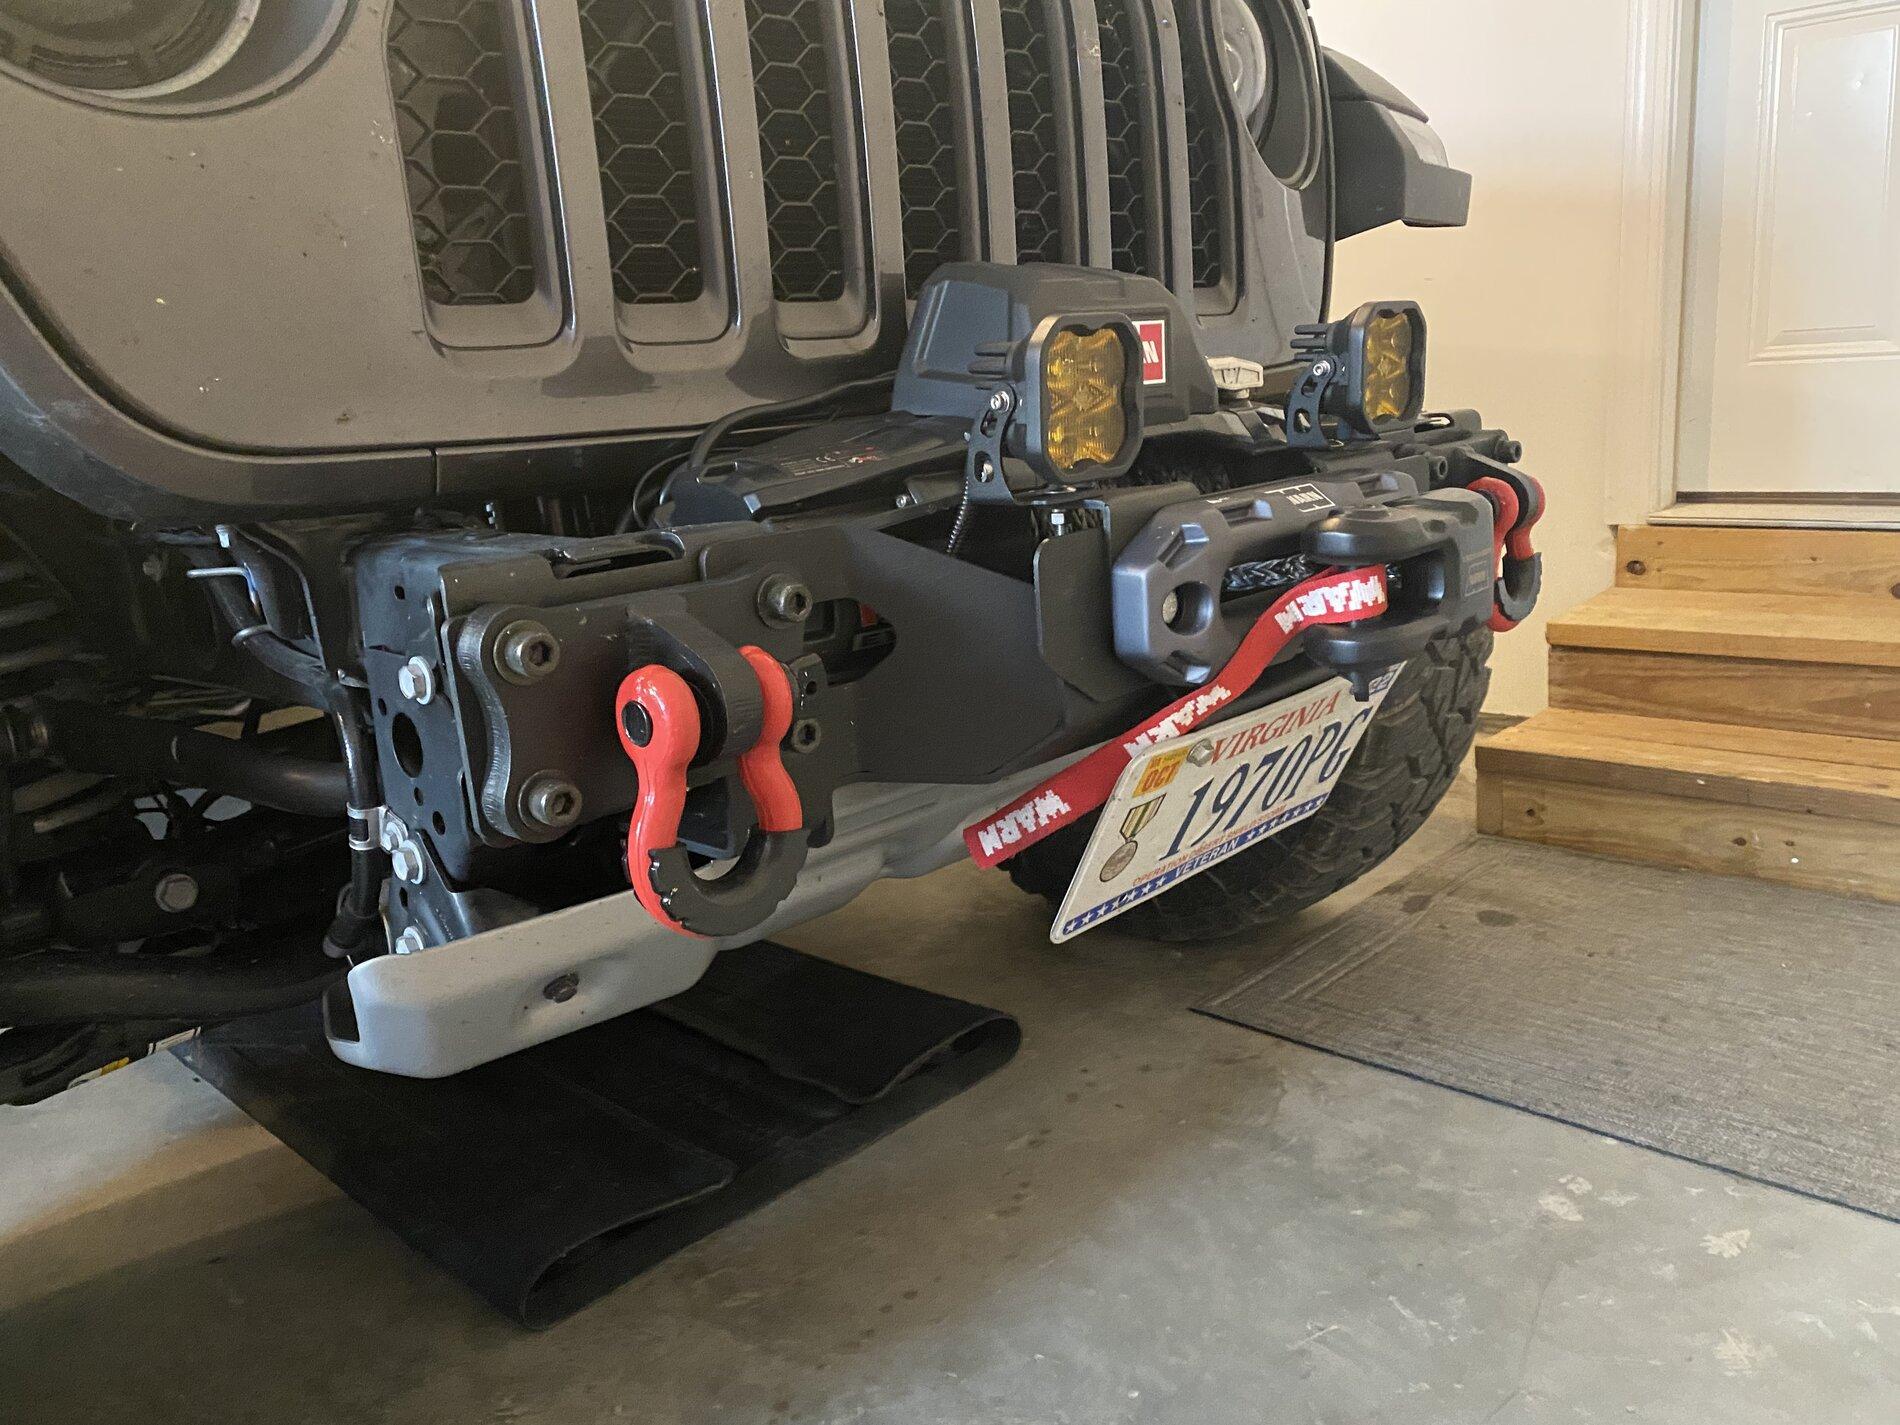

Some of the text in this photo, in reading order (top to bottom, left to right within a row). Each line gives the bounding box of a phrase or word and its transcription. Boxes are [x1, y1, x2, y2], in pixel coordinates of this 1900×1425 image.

[1274, 575, 1385, 634] WARN
[1210, 691, 1342, 765] VIRGINIA
[1142, 760, 1180, 792] OCT
[1158, 706, 1372, 861] 1970PG
[978, 790, 1071, 857] WARN
[1175, 838, 1240, 877] VETERAN
